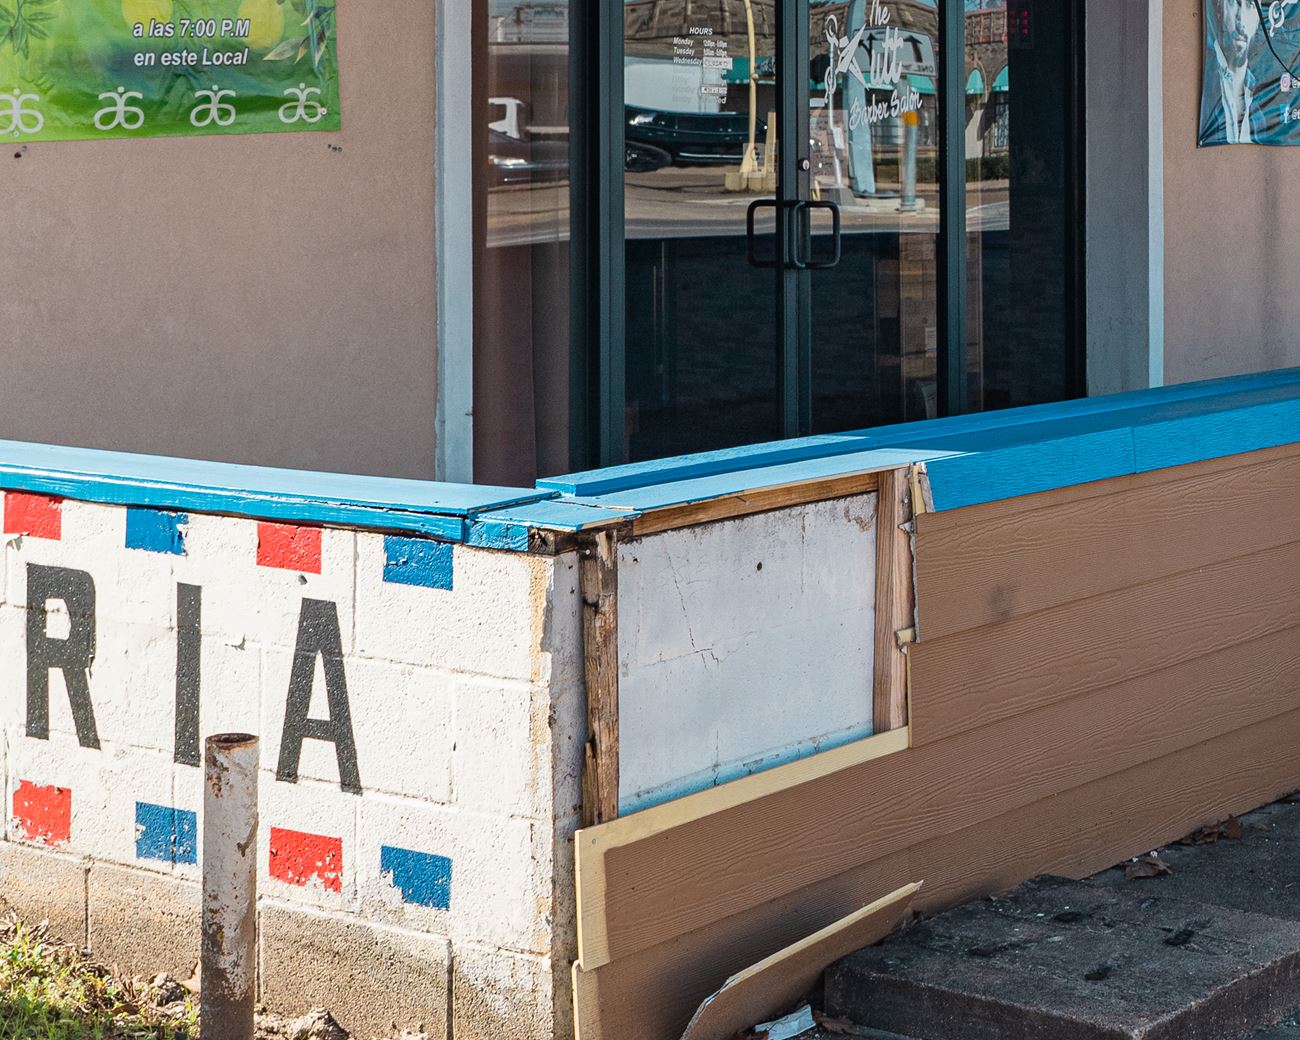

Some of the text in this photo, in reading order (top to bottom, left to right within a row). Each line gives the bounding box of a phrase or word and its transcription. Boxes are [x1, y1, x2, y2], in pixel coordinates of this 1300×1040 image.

[132, 19, 251, 39] a las 7:00 P.M
[689, 27, 713, 36] HOURS
[673, 37, 694, 47] Monday
[134, 47, 249, 67] en este Local
[673, 47, 695, 57] Tuesday
[673, 56, 703, 66] Wednesday
[849, 86, 922, 130] Barber Salon
